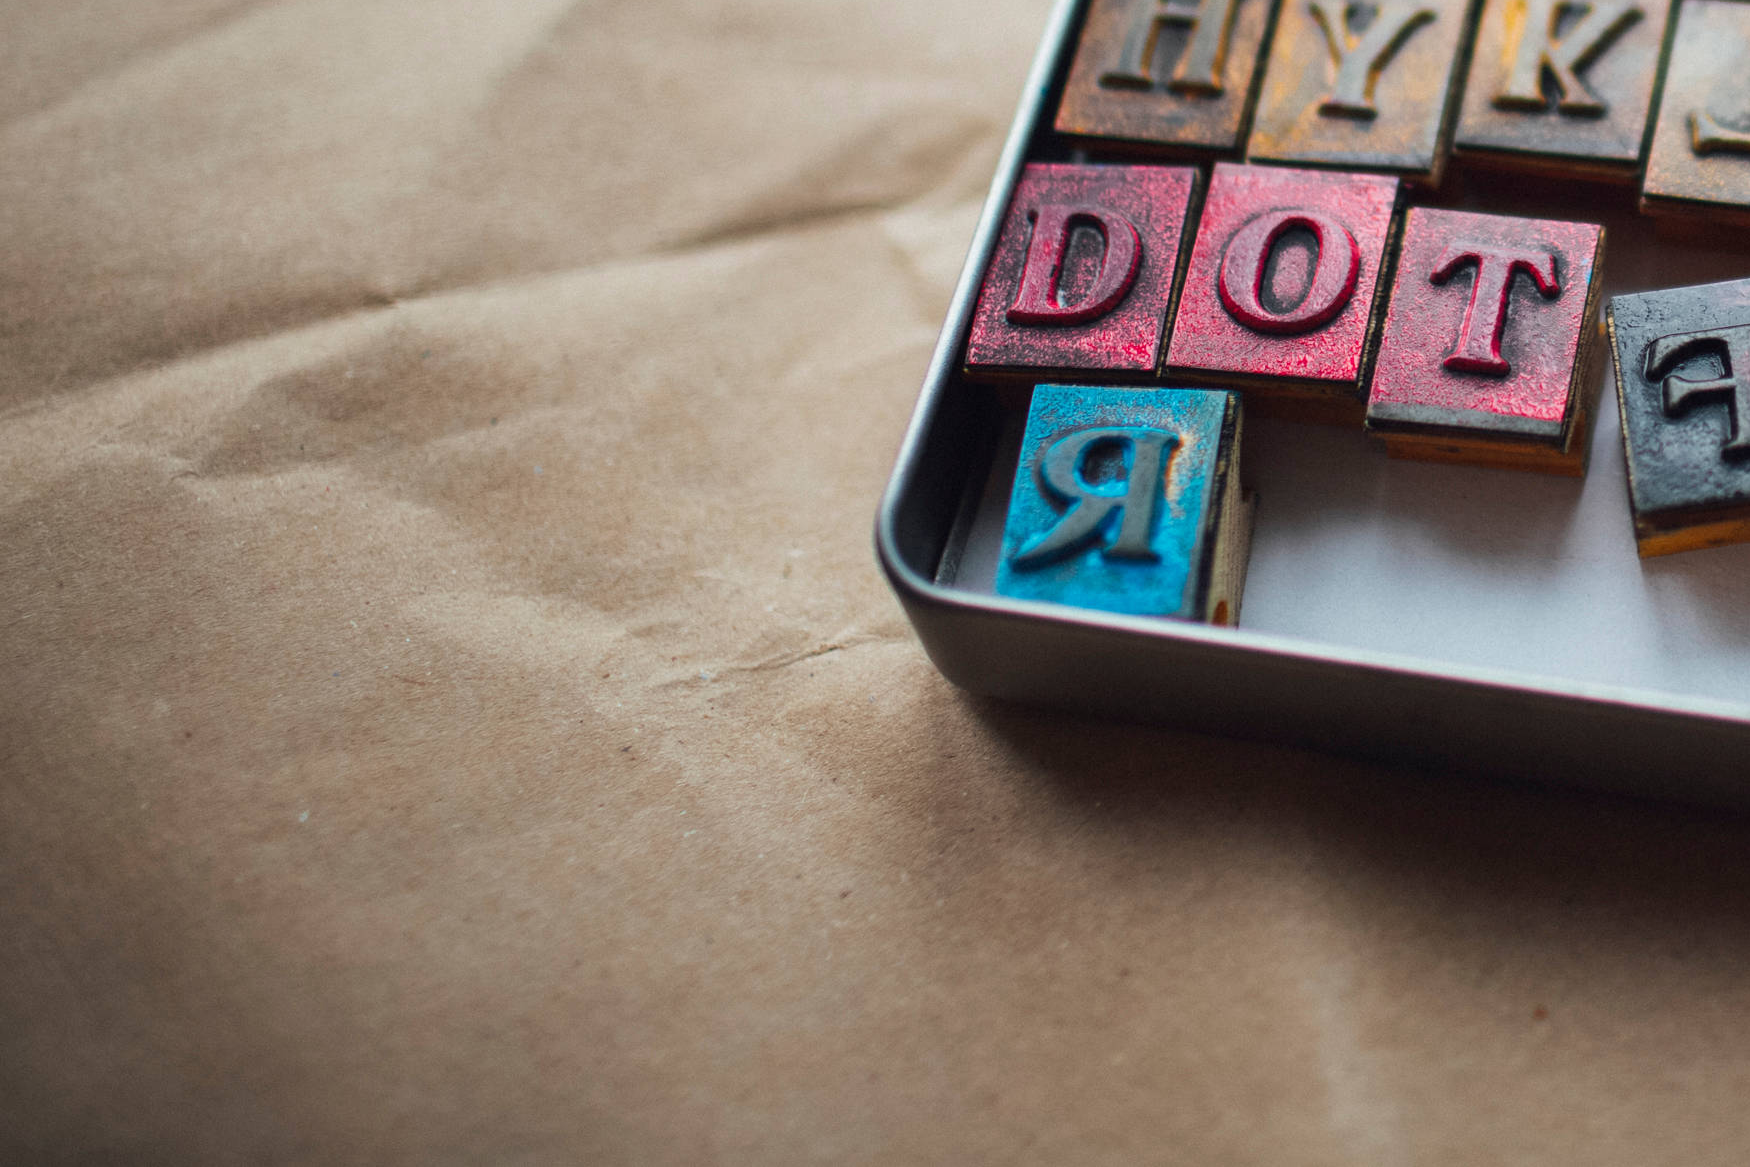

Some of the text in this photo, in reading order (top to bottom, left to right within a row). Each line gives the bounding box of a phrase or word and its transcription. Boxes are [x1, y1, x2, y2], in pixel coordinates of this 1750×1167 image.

[1308, 0, 1437, 120] Y
[1006, 204, 1144, 326] D
[1217, 206, 1362, 334] O
[1428, 242, 1561, 378] T
